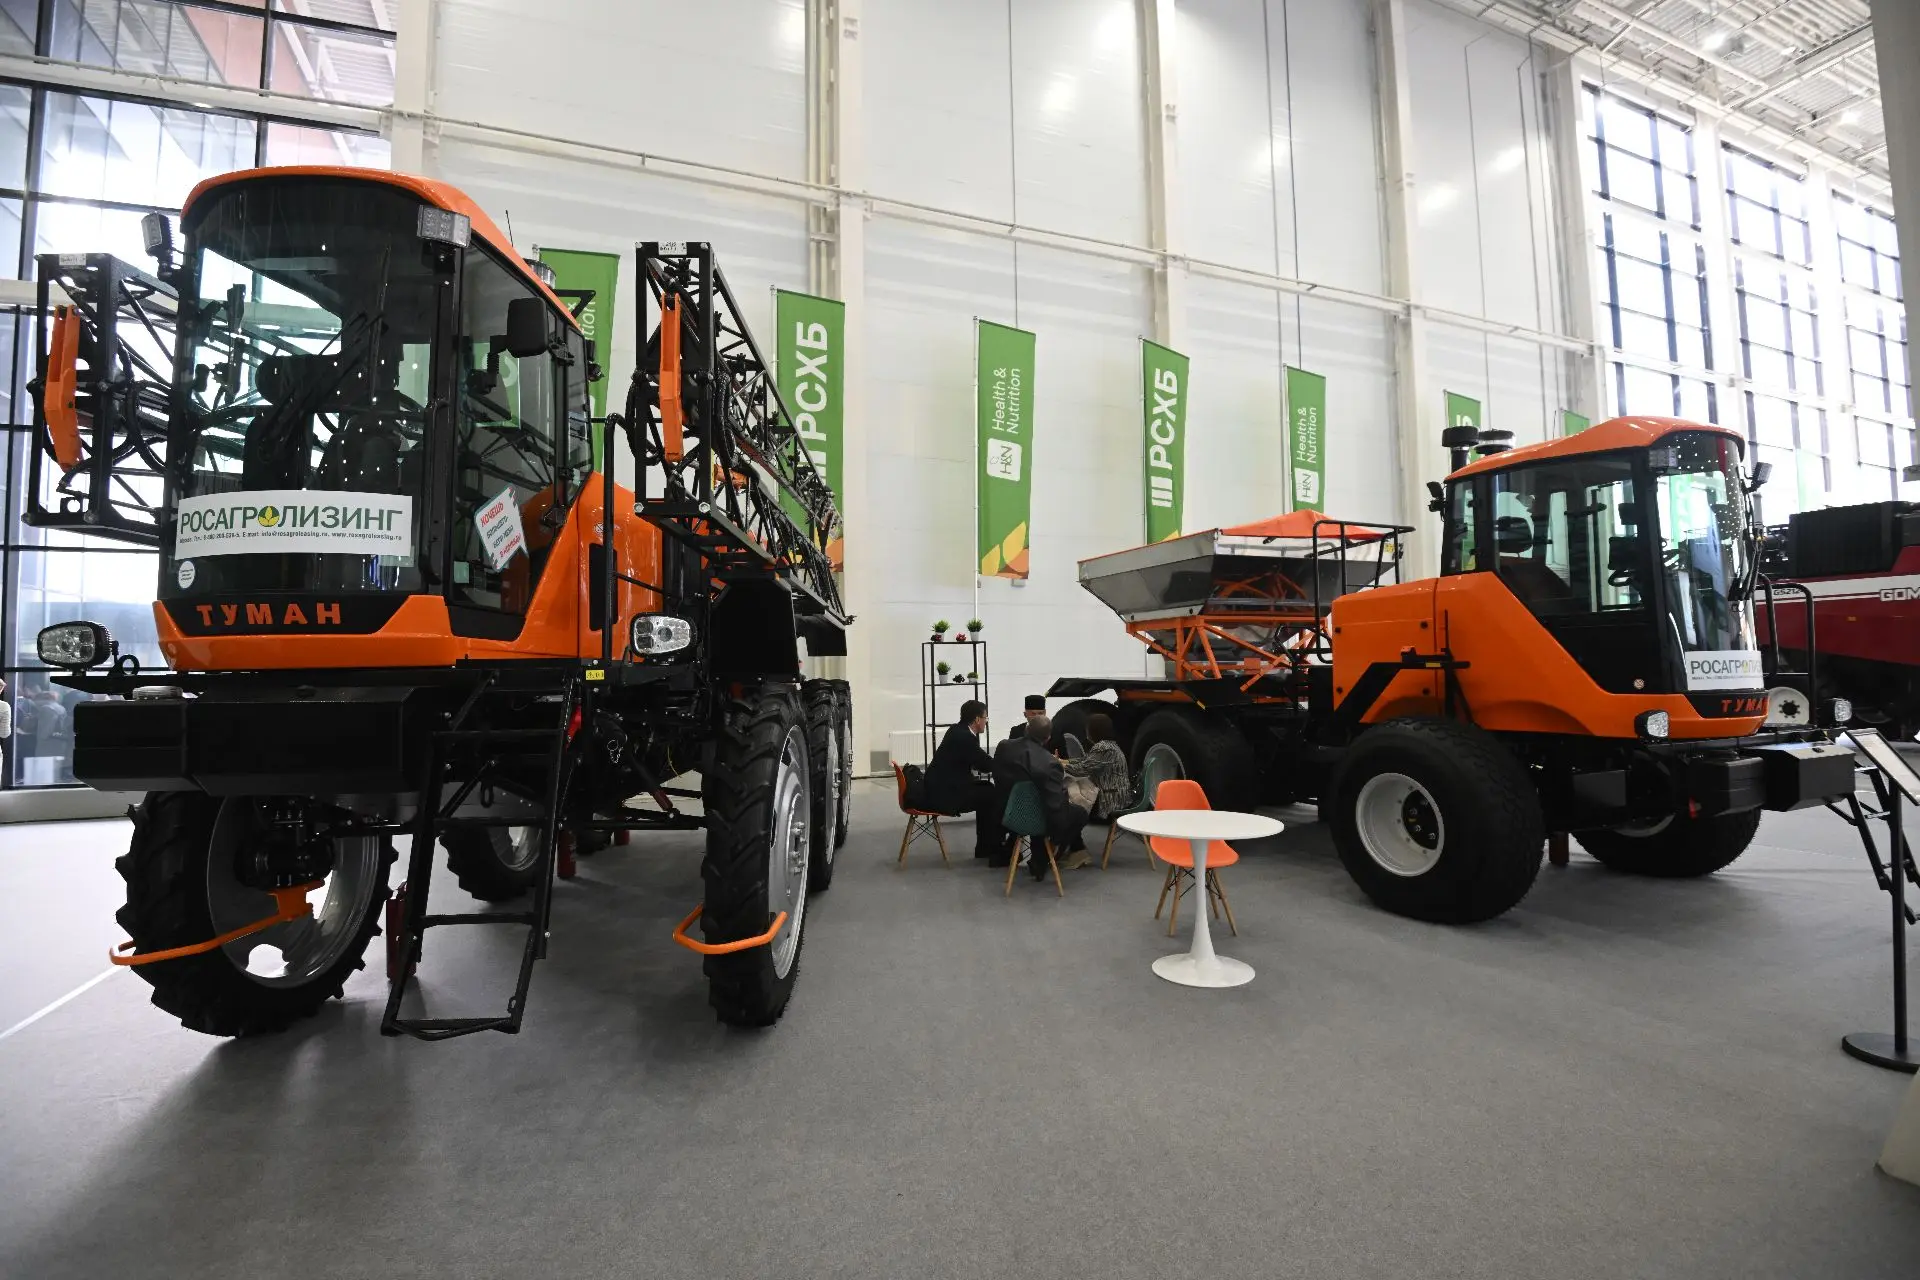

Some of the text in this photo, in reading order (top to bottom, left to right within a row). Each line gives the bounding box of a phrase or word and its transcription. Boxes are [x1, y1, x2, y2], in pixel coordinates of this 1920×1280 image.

[795, 321, 828, 442] РСХБ
[992, 367, 1007, 432] Health &
[1006, 368, 1021, 435] Nutrition
[1150, 367, 1178, 471] РСХБ
[1296, 407, 1307, 462] Health &
[1306, 407, 1317, 464] Nutrition
[196, 602, 341, 627] ТУМАН
[1773, 588, 1804, 596] GS212
